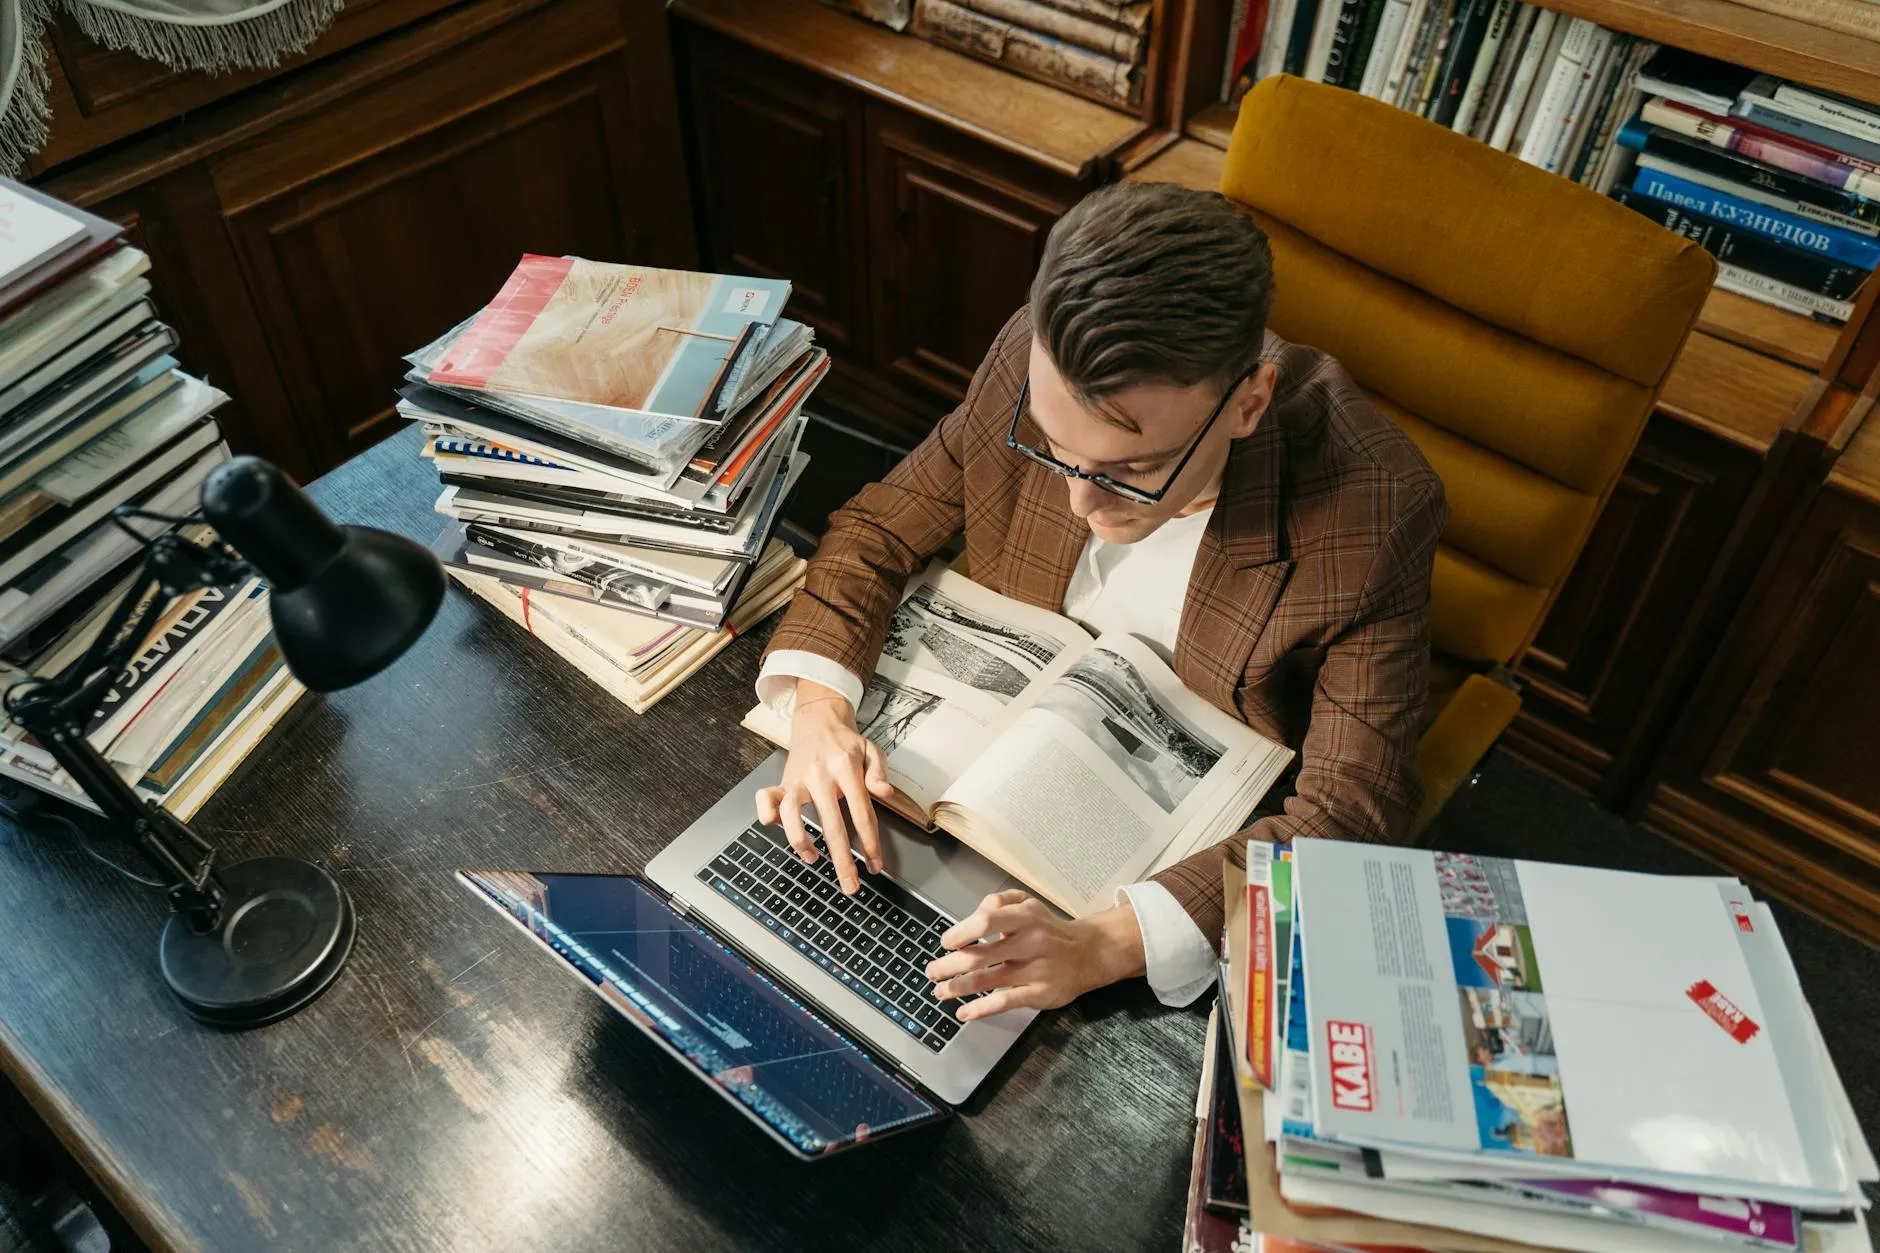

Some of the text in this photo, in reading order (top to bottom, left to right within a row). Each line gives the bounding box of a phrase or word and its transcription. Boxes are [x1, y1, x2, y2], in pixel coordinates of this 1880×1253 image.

[1647, 181, 1706, 211] Павел
[1711, 200, 1830, 252] КУЗНЕЦОВ
[1330, 1023, 1369, 1107] KABE
